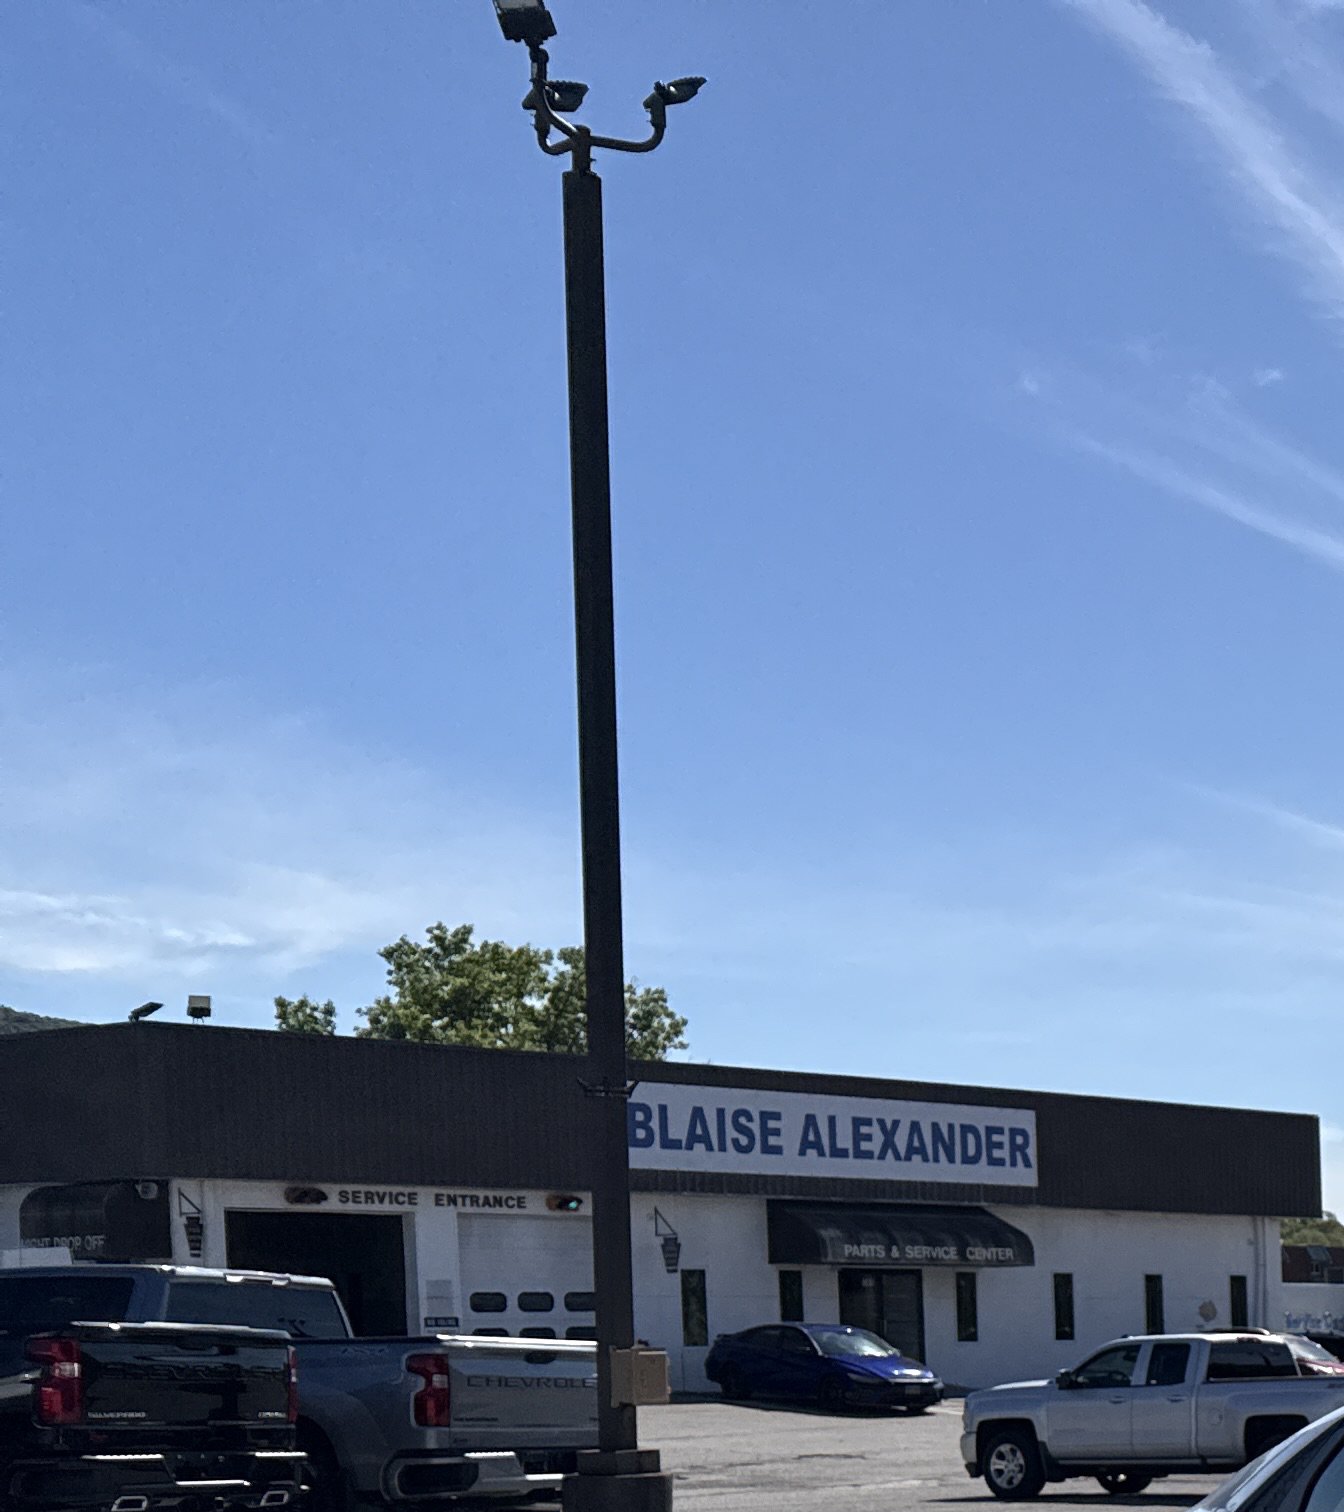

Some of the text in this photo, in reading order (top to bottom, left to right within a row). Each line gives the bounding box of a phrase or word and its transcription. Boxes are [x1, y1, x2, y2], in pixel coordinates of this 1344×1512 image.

[628, 1101, 1033, 1169] BLAISE ALEXANDER
[338, 1190, 527, 1210] SERVICE ENTRANCE
[21, 1235, 105, 1251] GHT DROP OFF
[843, 1244, 1015, 1261] PARTS & SERVICE CENTER
[466, 1376, 597, 1388] CHEVROLE
